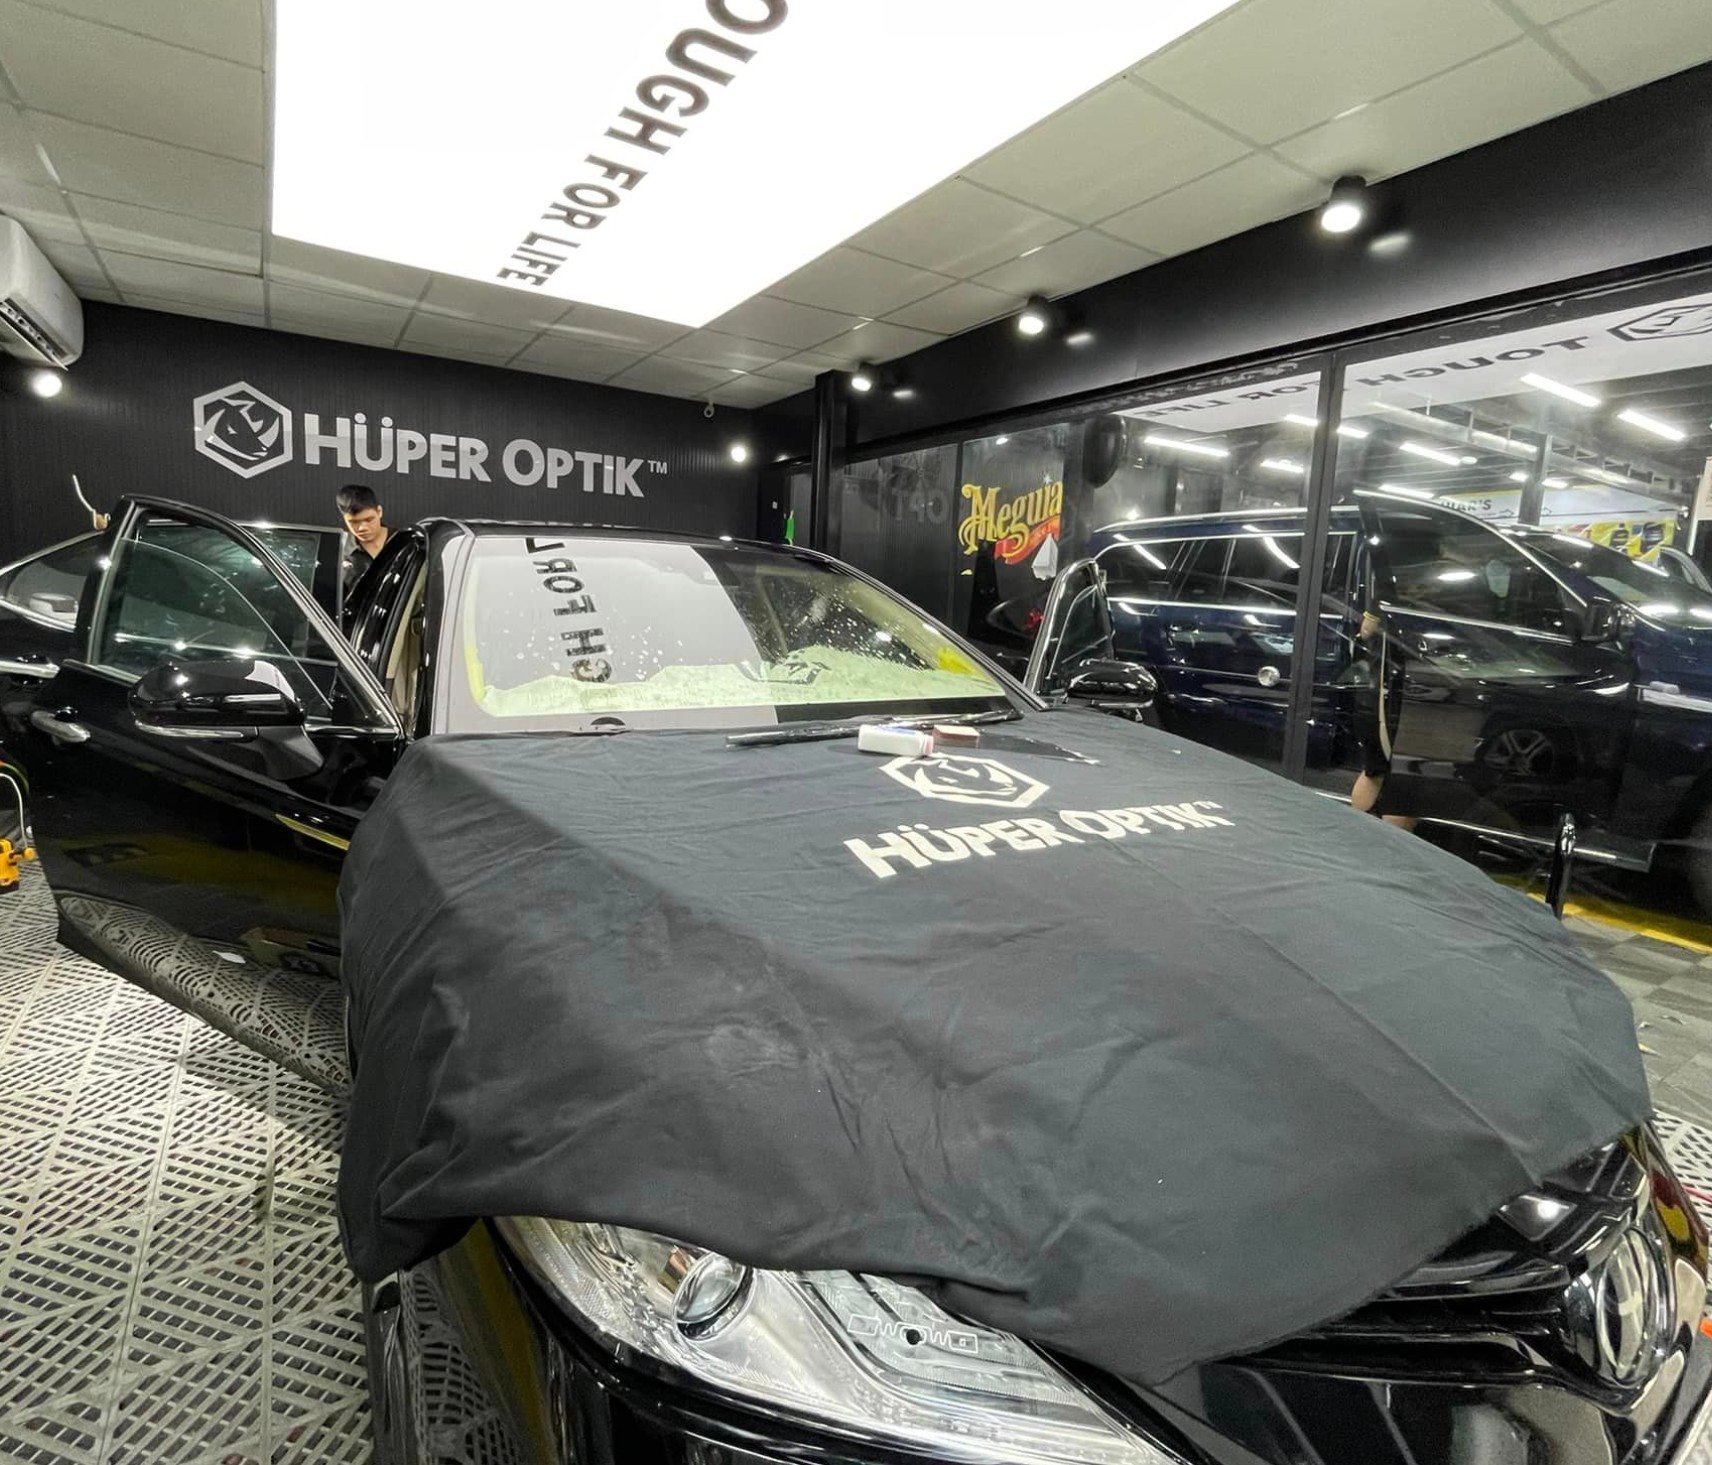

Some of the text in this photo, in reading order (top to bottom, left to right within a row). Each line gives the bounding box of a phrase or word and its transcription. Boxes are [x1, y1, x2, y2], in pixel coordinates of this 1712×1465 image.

[541, 154, 648, 229] FOR
[496, 232, 581, 287] LIFE
[304, 412, 492, 482] HÜPER
[843, 823, 1086, 879] HÜPER
